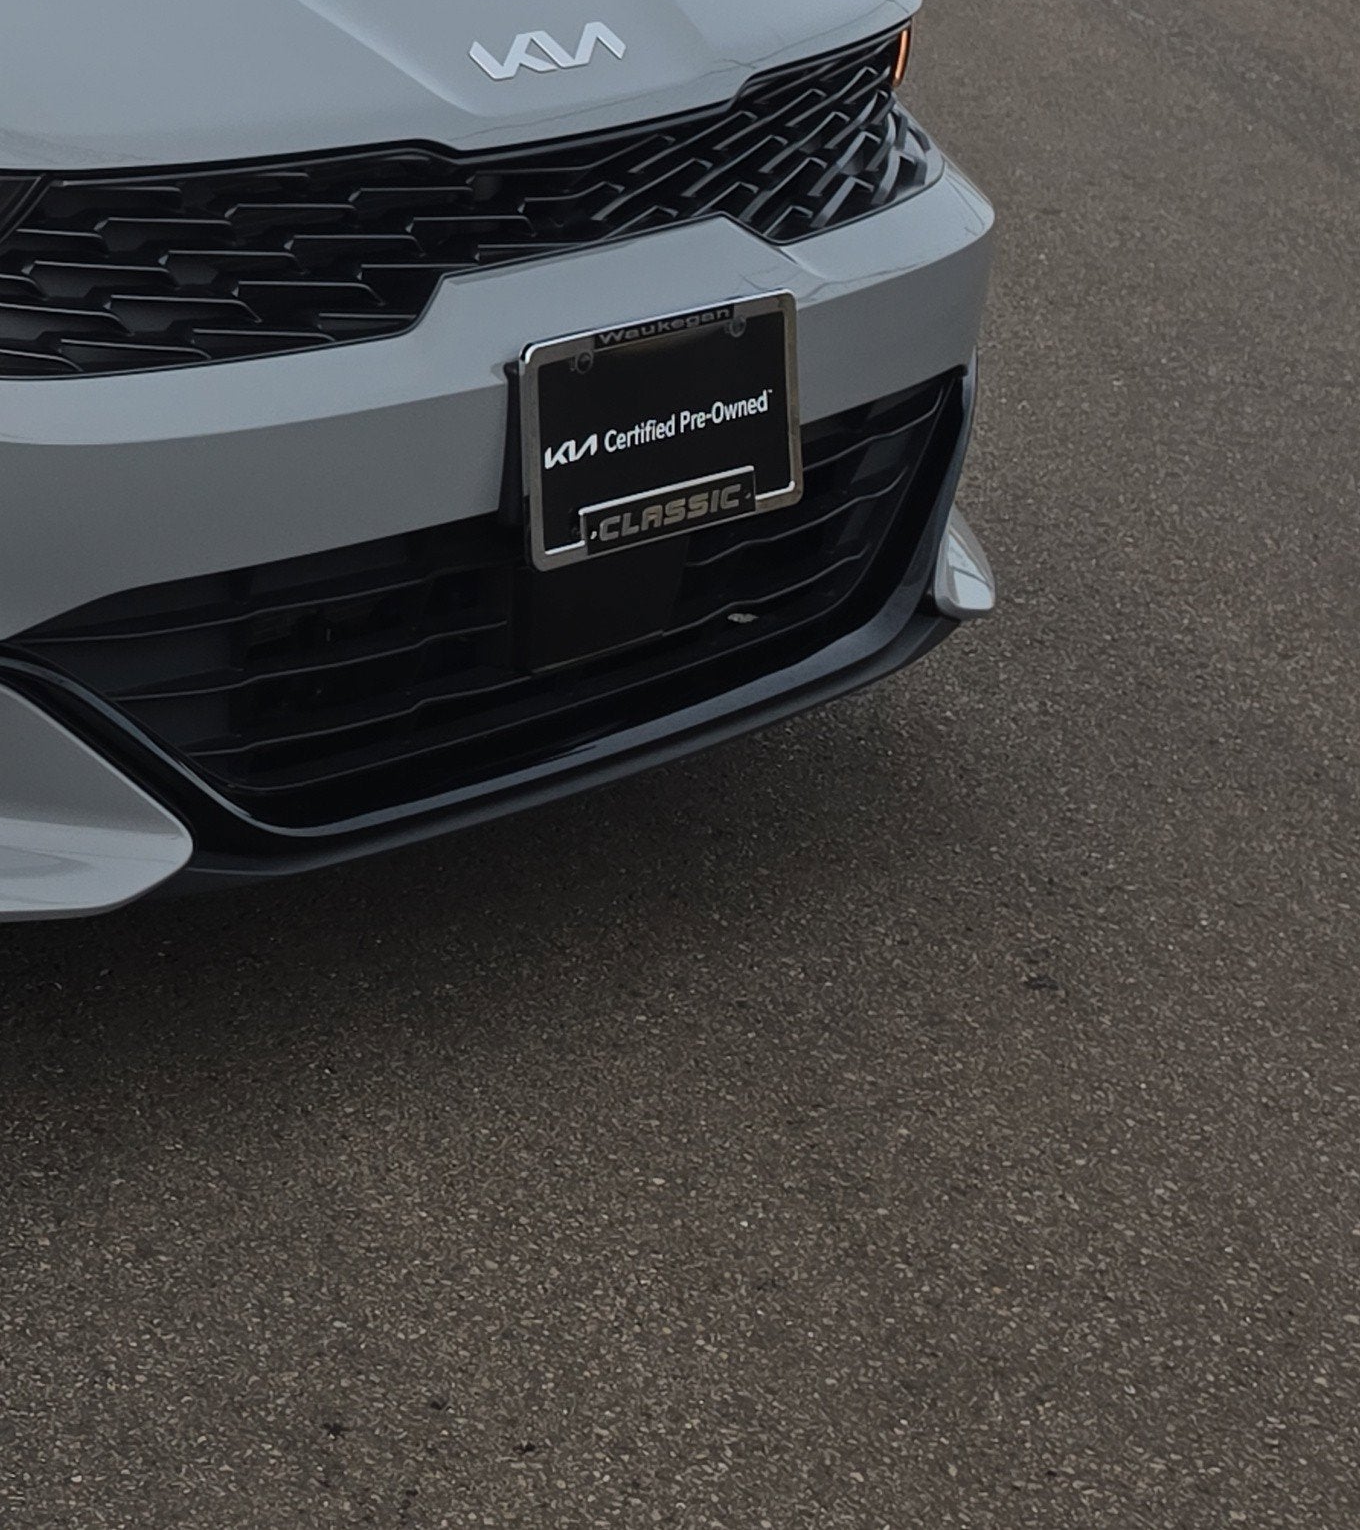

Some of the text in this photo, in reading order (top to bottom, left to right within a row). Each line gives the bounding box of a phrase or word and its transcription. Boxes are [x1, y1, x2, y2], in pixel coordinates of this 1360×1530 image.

[469, 21, 627, 81] KIA
[598, 307, 731, 345] Waukegan
[544, 433, 598, 470] KIA
[604, 413, 676, 453] Certified
[598, 483, 742, 542] CLASSIC
